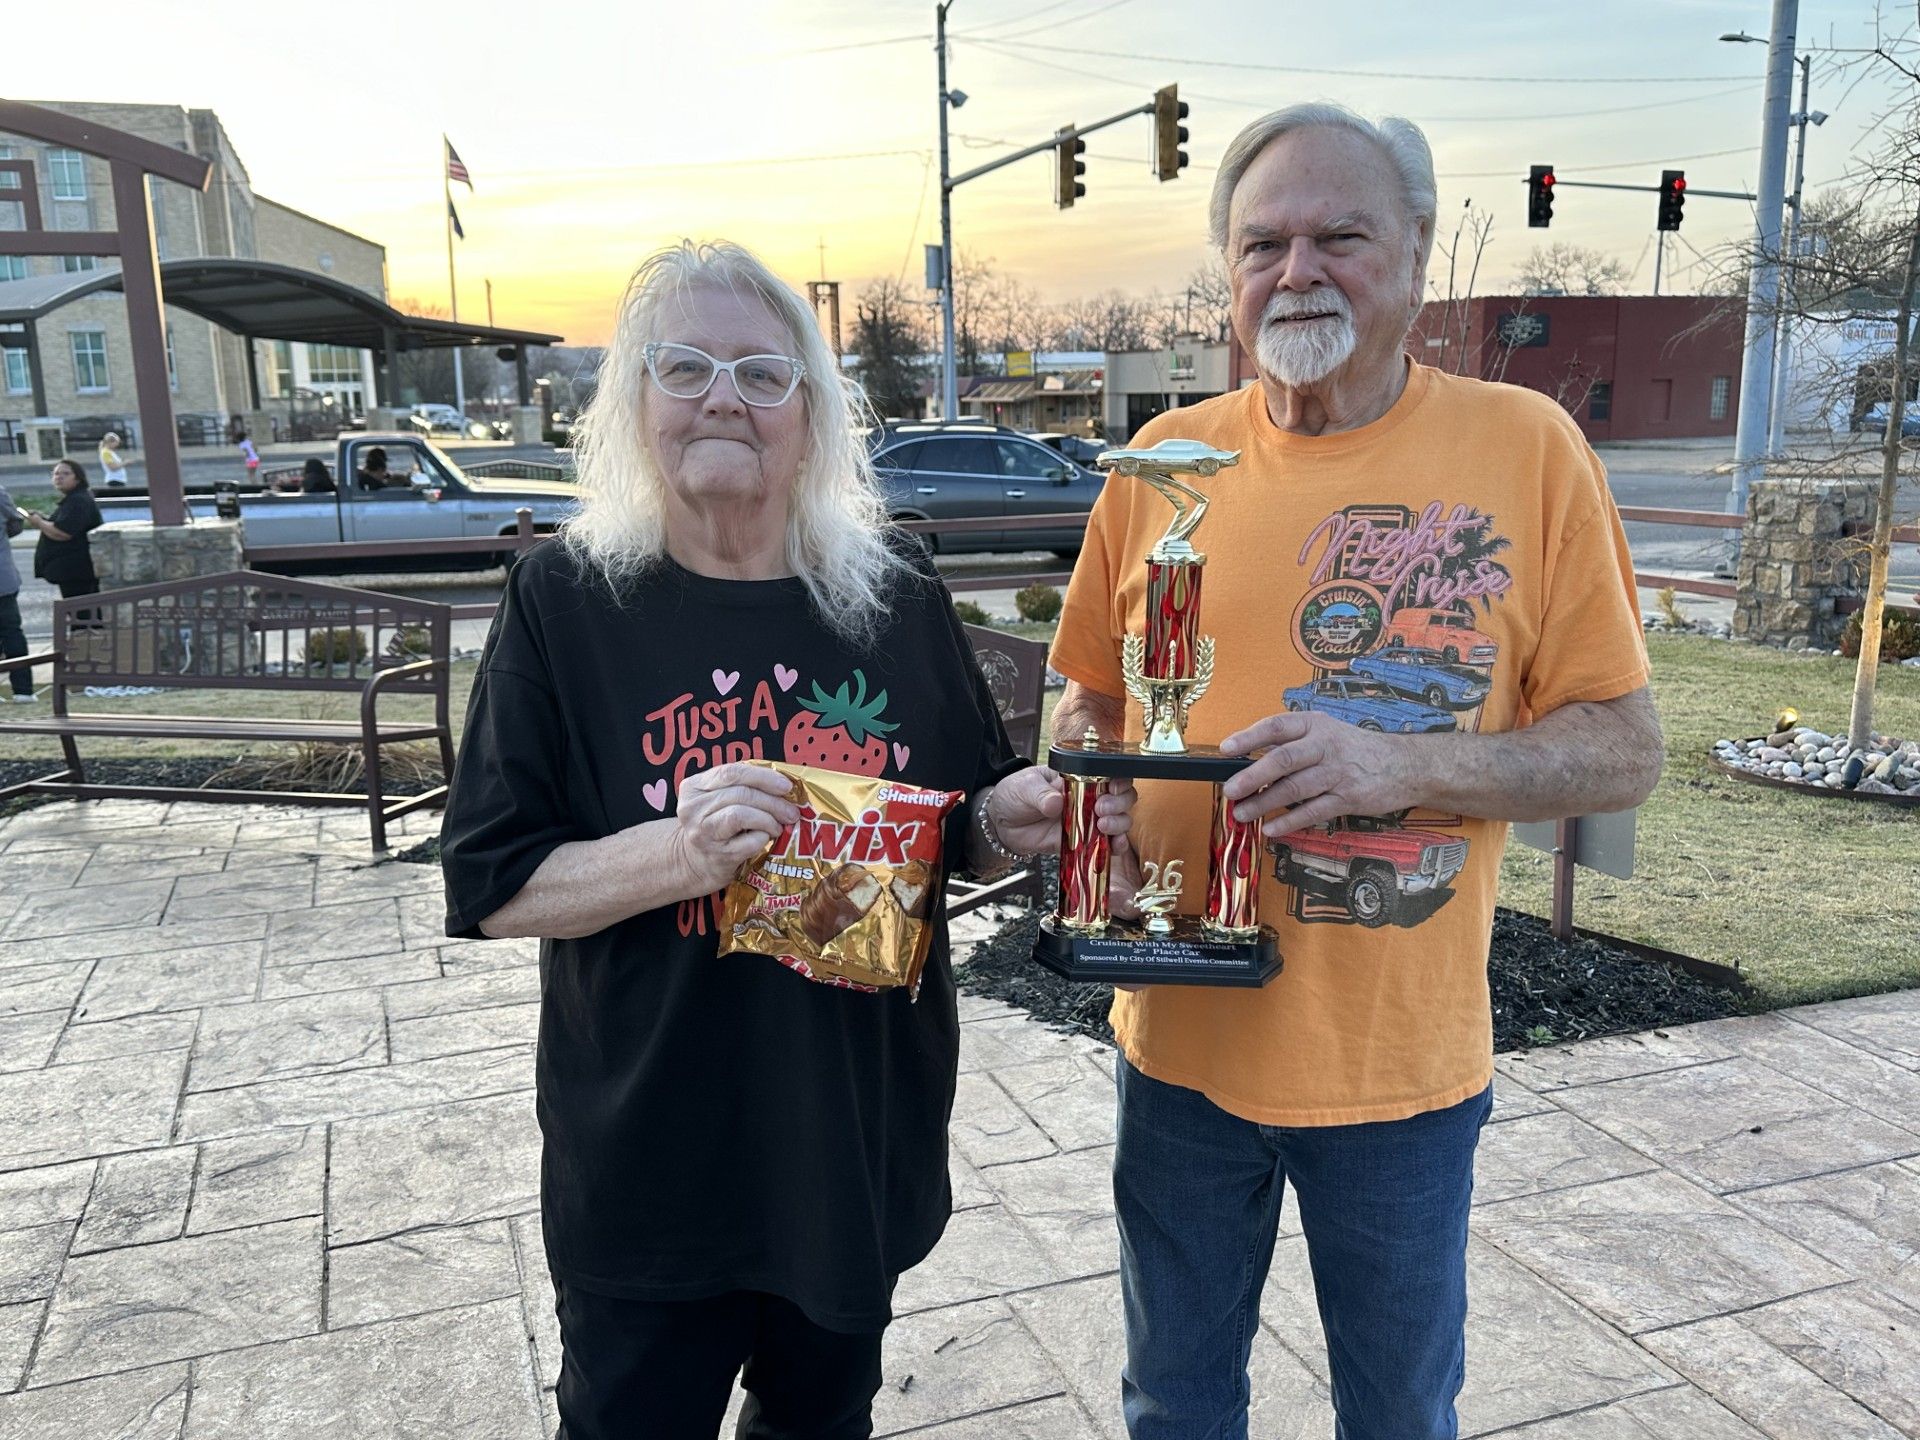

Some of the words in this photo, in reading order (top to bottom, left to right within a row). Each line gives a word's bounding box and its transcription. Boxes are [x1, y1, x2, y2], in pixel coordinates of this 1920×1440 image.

[1298, 500, 1488, 586] Night
[1311, 637, 1363, 654] Coast
[642, 692, 743, 766] JUST
[749, 680, 779, 731] A
[1140, 859, 1184, 894] 26
[1089, 939, 1133, 948] Cruising
[1161, 941, 1177, 949] My
[1179, 942, 1237, 951] Sweetheart
[1153, 948, 1180, 956] Place
[1080, 954, 1118, 962] Sponsored
[1119, 955, 1128, 963] By
[1129, 955, 1144, 963] City
[1156, 956, 1183, 964] Stilwell
[1184, 957, 1208, 965] Events
[1209, 958, 1249, 967] Committee
